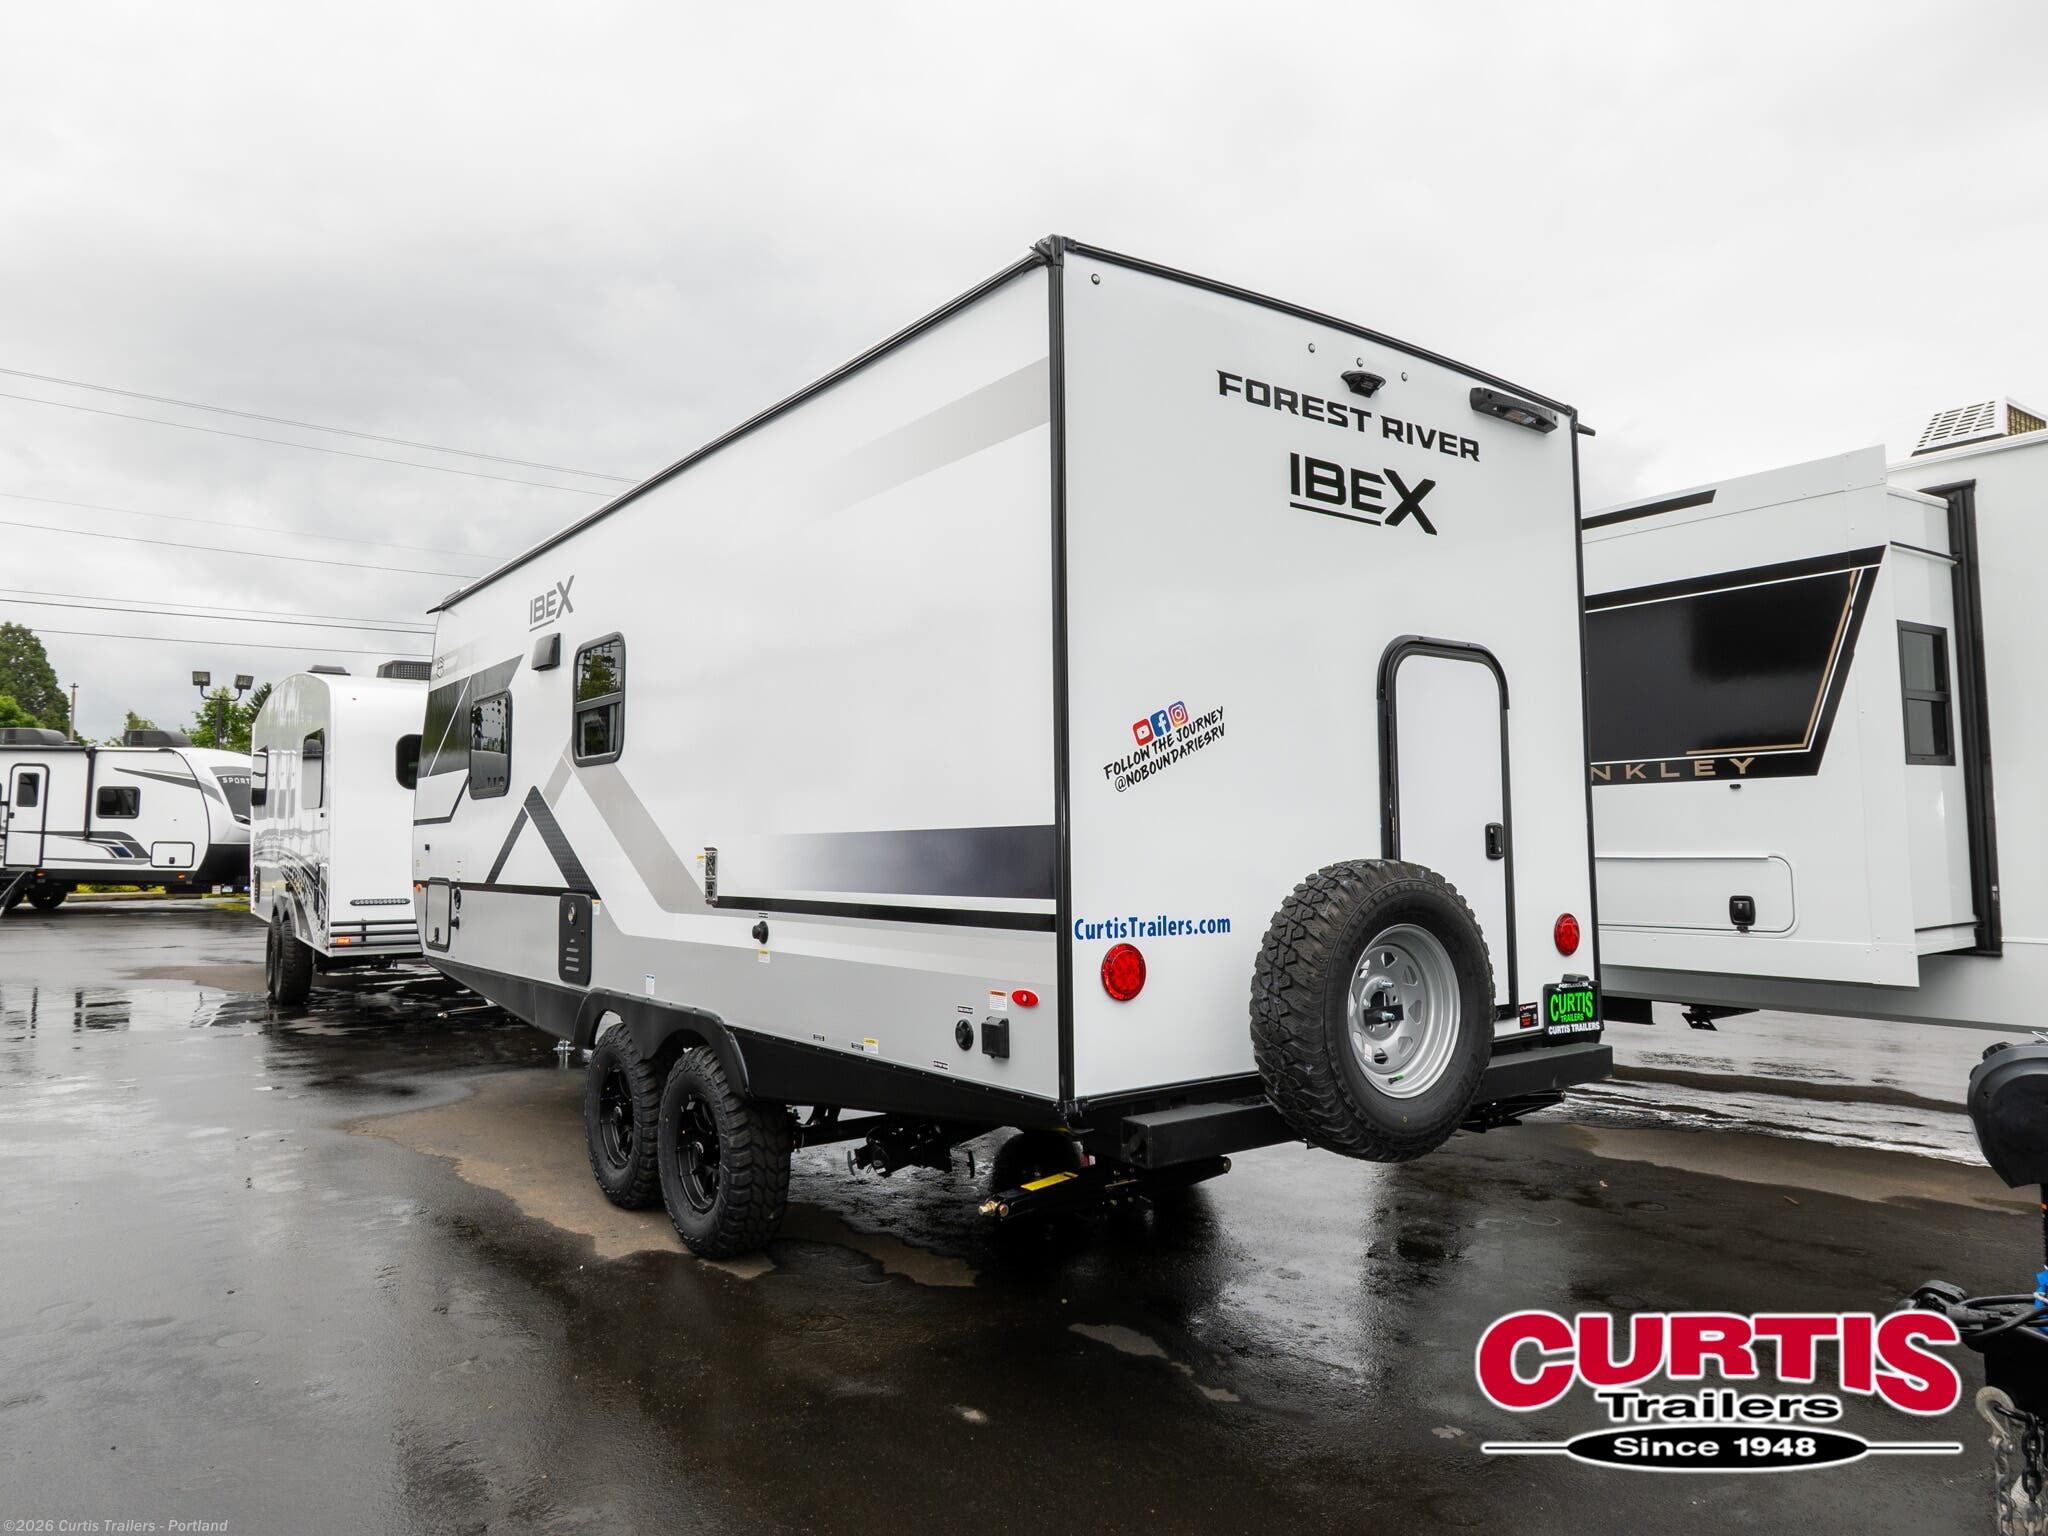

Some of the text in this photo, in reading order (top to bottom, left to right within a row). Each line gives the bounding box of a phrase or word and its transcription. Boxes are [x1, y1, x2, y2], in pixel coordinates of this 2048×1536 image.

[1216, 369, 1481, 462] FOREST RIVER
[1289, 452, 1438, 536] IBEX
[529, 575, 575, 626] IBEX
[1103, 706, 1225, 780] FOLLOW THE JOURNEY
[1114, 722, 1226, 793] @NOBOUNDARIESRV
[1074, 915, 1231, 941] CurtisTrailers.com
[1548, 1022, 1600, 1035] CURTIS TRAILERS
[1551, 991, 1593, 1022] CURTIS
[1561, 1013, 1584, 1022] TRAILERS
